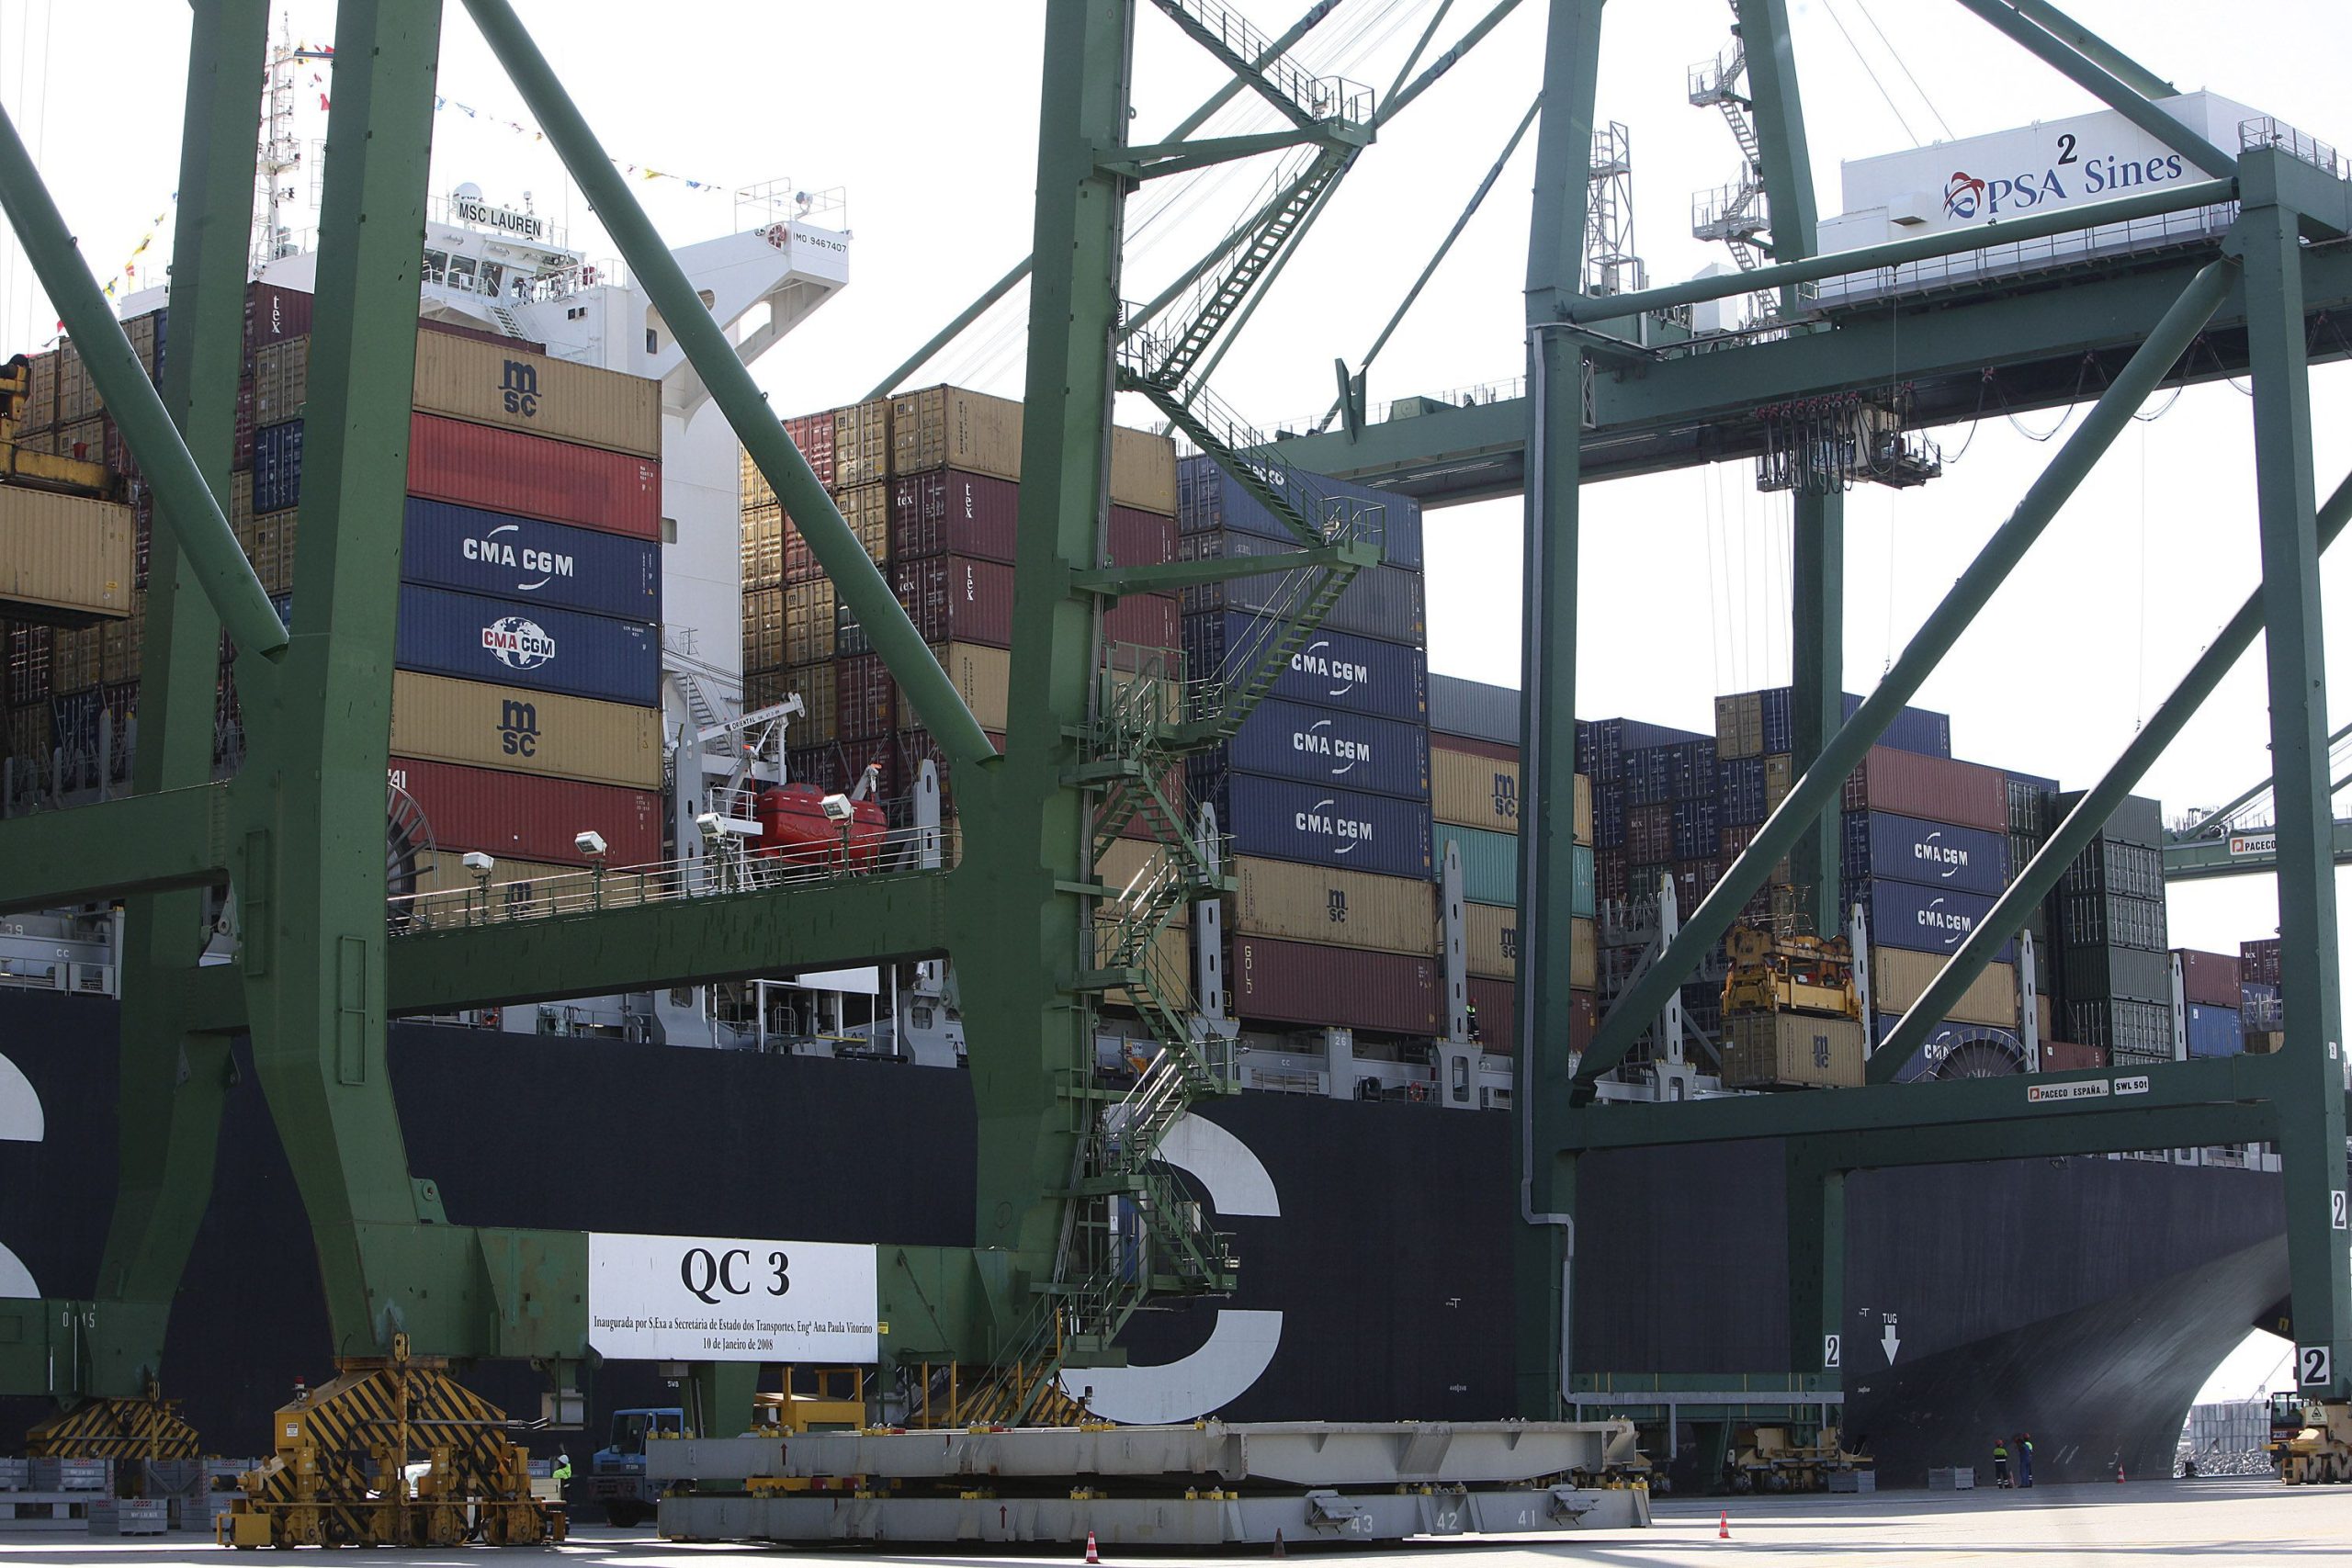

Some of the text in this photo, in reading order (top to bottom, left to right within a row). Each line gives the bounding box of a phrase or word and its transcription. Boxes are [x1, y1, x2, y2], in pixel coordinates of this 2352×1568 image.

[2057, 133, 2078, 165] 2
[1987, 154, 2182, 214] PSA Sines
[458, 202, 542, 237] MSC LAUREN
[793, 231, 847, 254] IMO 9467407
[272, 295, 281, 333] tex
[897, 494, 912, 506] tex
[965, 482, 973, 519] tex
[463, 537, 573, 578] CMA CGM
[483, 630, 553, 657] CMA CGM
[1291, 653, 1368, 684] CMA CGM
[731, 716, 756, 730] ORIENTAL
[1294, 732, 1370, 762] CMA CGM
[1295, 812, 1373, 841] CMA CGM
[1915, 843, 1968, 867] CMA CGM
[2245, 840, 2277, 852] PACECO
[1917, 909, 1972, 932] CMA CGM
[1244, 945, 1253, 994] GOLD
[1335, 1036, 1347, 1046] 26
[2041, 1089, 2068, 1100] PACECO
[2073, 1084, 2101, 1097] ESPAÑA
[2115, 1080, 2147, 1091] SWL 50t
[2334, 1192, 2346, 1227] 2
[681, 1247, 790, 1305] QC 3
[594, 1315, 634, 1332] Inaugurada
[635, 1318, 648, 1333] por
[669, 1320, 673, 1329] a
[674, 1317, 708, 1331] Secretária
[709, 1318, 718, 1330] de
[718, 1318, 741, 1331] Estado
[742, 1319, 755, 1331] dos
[755, 1319, 797, 1336] Transportes,
[812, 1321, 827, 1333] Ana
[827, 1321, 845, 1334] Paula
[846, 1322, 873, 1334] Vitorino
[1882, 1313, 1898, 1324] TUG
[703, 1337, 774, 1351] 10 de Janeiro de 2008
[1826, 1337, 1838, 1366] 2
[2304, 1348, 2327, 1384] 2
[1351, 1516, 1374, 1533] 43
[1436, 1512, 1458, 1531] 42
[1518, 1509, 1536, 1528] 41
